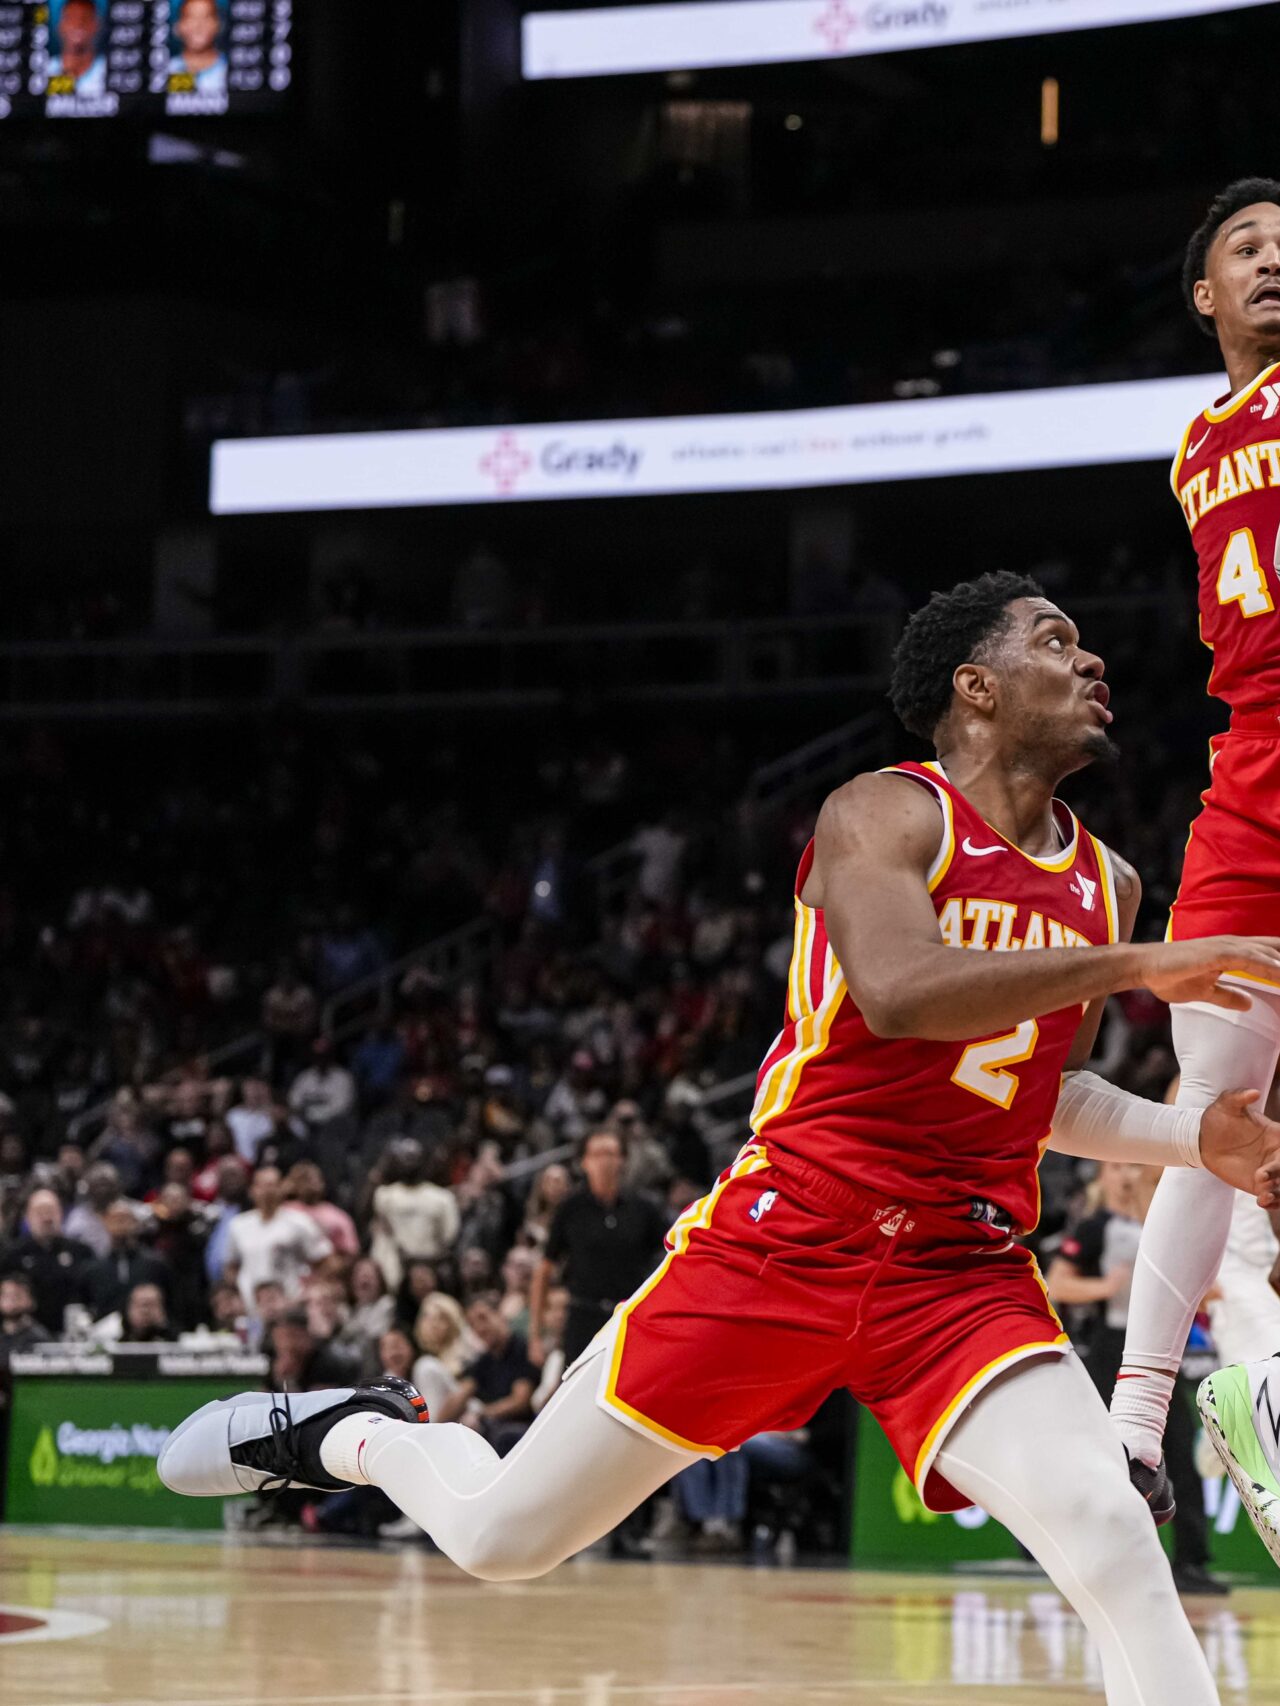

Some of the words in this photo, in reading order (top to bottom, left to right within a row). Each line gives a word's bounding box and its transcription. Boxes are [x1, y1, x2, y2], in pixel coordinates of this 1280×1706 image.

[542, 440, 642, 480] Grady
[1216, 527, 1275, 619] 4
[950, 1018, 1039, 1111] 2
